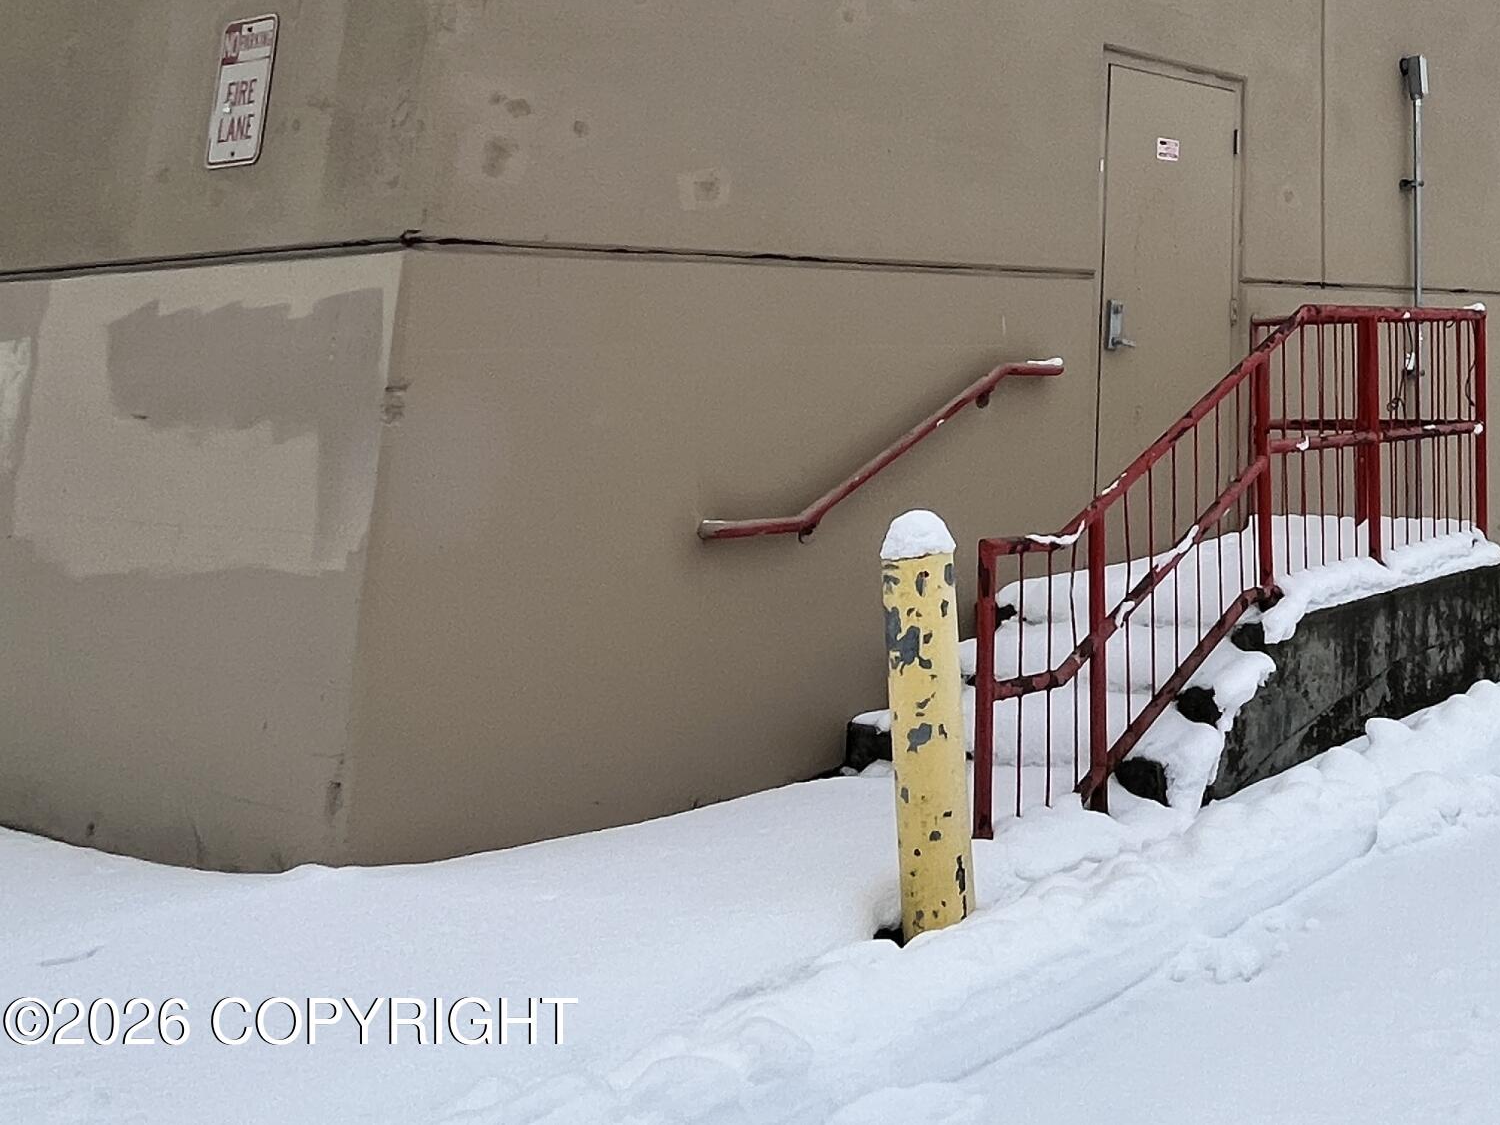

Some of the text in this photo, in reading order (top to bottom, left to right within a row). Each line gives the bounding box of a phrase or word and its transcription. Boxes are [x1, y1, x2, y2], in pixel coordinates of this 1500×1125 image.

[224, 31, 240, 58] NO
[224, 78, 257, 106] FIRE
[218, 114, 254, 143] LANE
